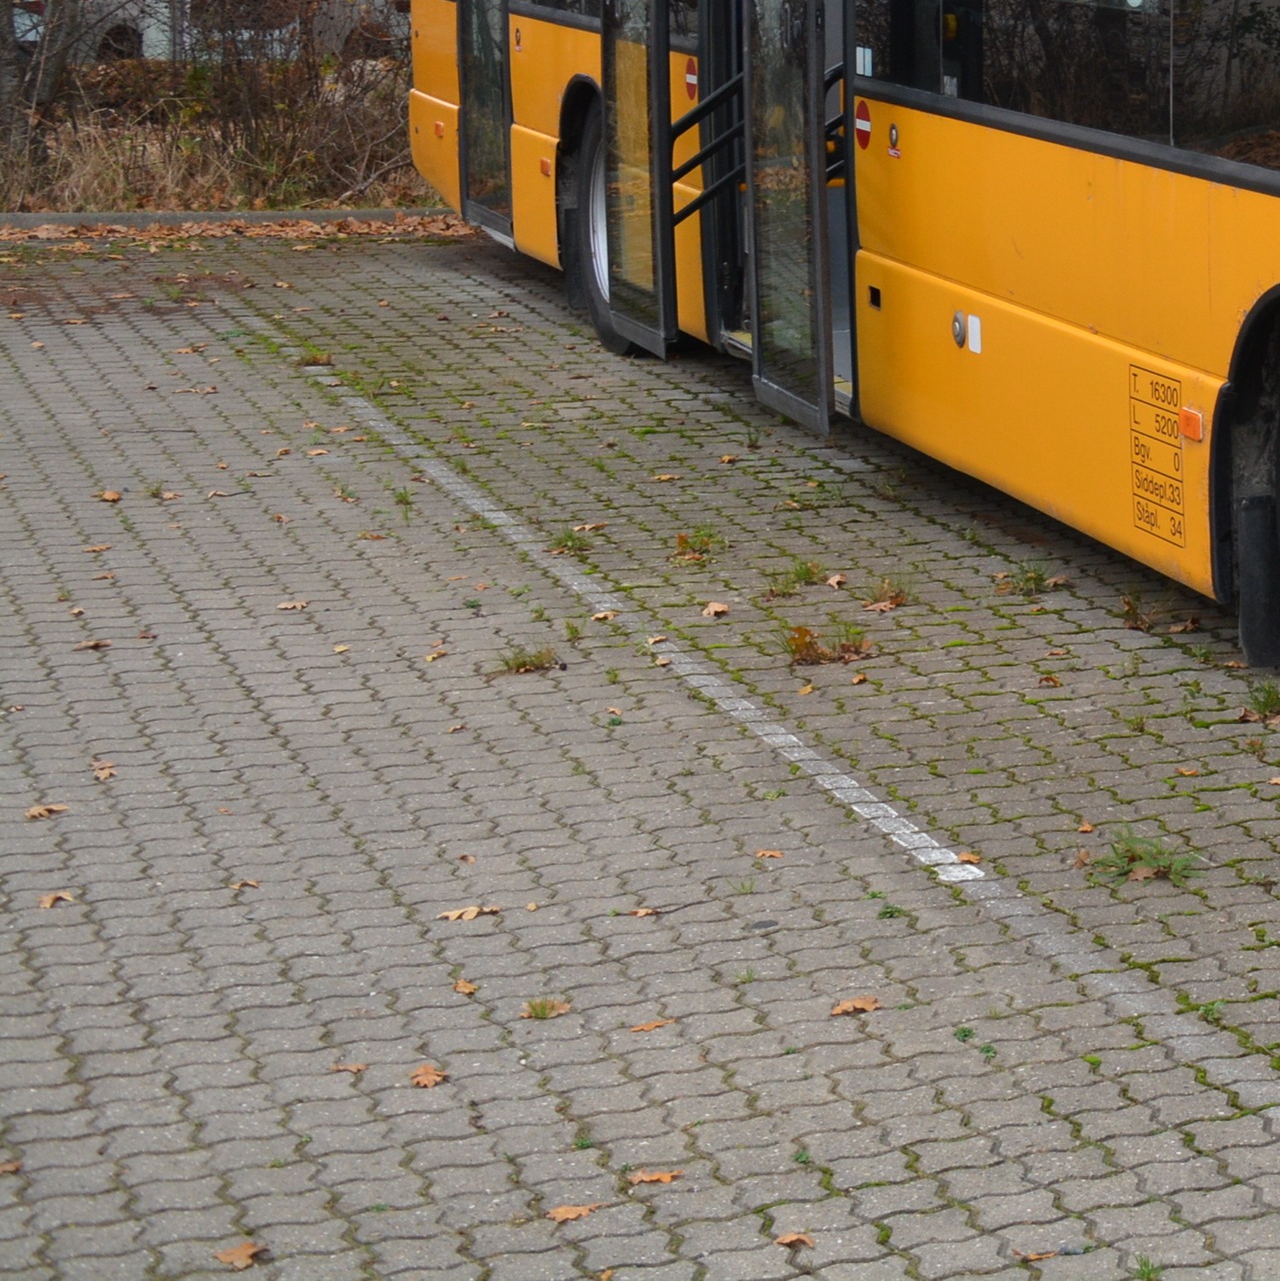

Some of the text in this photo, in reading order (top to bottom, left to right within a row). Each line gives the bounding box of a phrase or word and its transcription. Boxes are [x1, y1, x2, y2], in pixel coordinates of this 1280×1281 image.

[1132, 373, 1178, 407] T. 16300
[1155, 413, 1179, 440] 5200
[1134, 436, 1180, 472] Bgv. 0
[1137, 501, 1183, 539] Ståpl. 34
